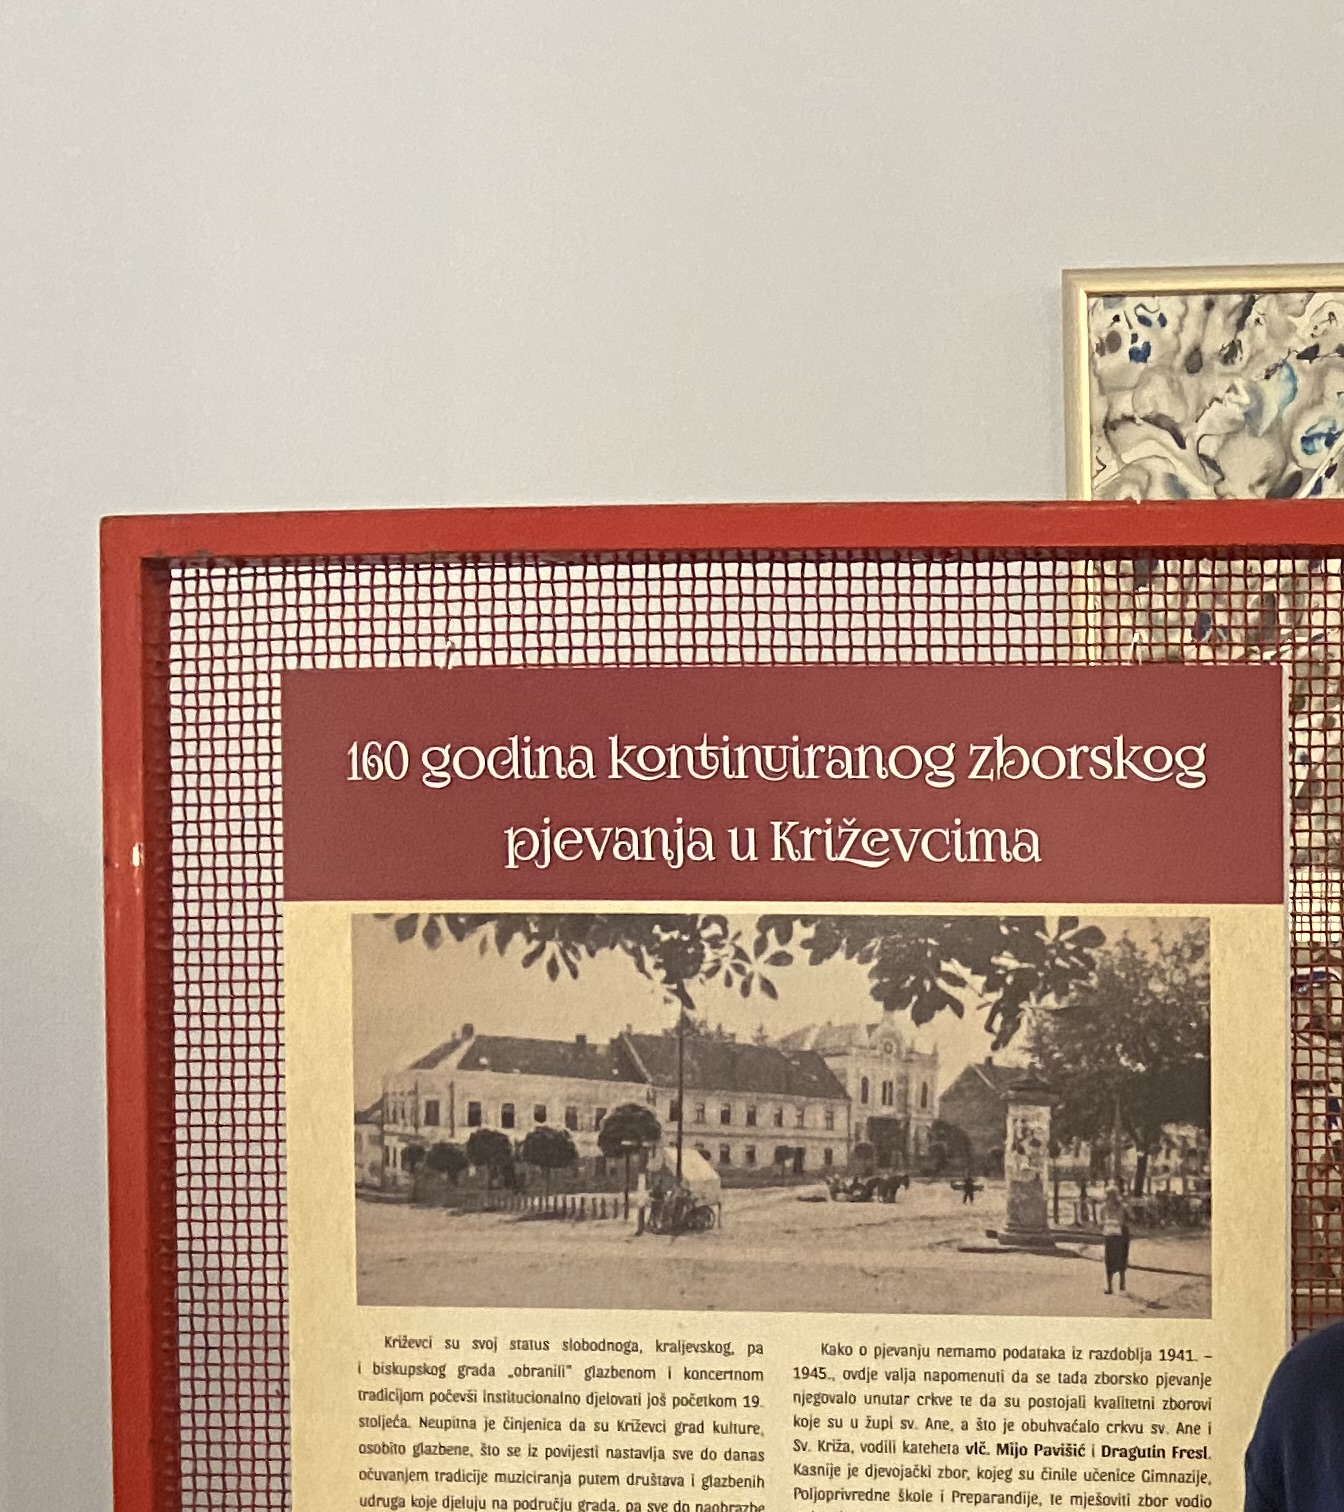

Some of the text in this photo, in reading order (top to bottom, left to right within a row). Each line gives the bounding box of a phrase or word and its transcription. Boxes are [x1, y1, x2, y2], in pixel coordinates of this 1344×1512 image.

[347, 733, 1206, 789] 160 godina kontinuiranog zborskog
[504, 817, 1042, 869] pjevanja u Križevcima
[385, 1334, 433, 1349] Križevci
[445, 1338, 460, 1350] su
[472, 1335, 498, 1353] svoj
[510, 1339, 550, 1350] status
[748, 1343, 764, 1357] pa
[821, 1341, 854, 1356] Kako
[859, 1345, 868, 1356] o
[874, 1343, 931, 1360] pjevanju
[937, 1346, 997, 1358] nemamo
[1003, 1344, 1066, 1361] podataka
[1072, 1345, 1083, 1360] iz
[1089, 1346, 1153, 1364] razdoblja
[373, 1360, 447, 1379] biskupskog
[457, 1362, 496, 1380] grada
[684, 1366, 764, 1382] koncertnom
[793, 1438, 811, 1452] Sv.
[818, 1438, 855, 1454] Križa,
[860, 1439, 896, 1453] vodili
[903, 1440, 960, 1454] kateheta
[966, 1440, 991, 1455] vlč.
[997, 1441, 1028, 1458] Mijo
[1034, 1442, 1086, 1457] Pavišić
[1102, 1444, 1166, 1461] Dragutin
[1172, 1445, 1212, 1460] Fresl.
